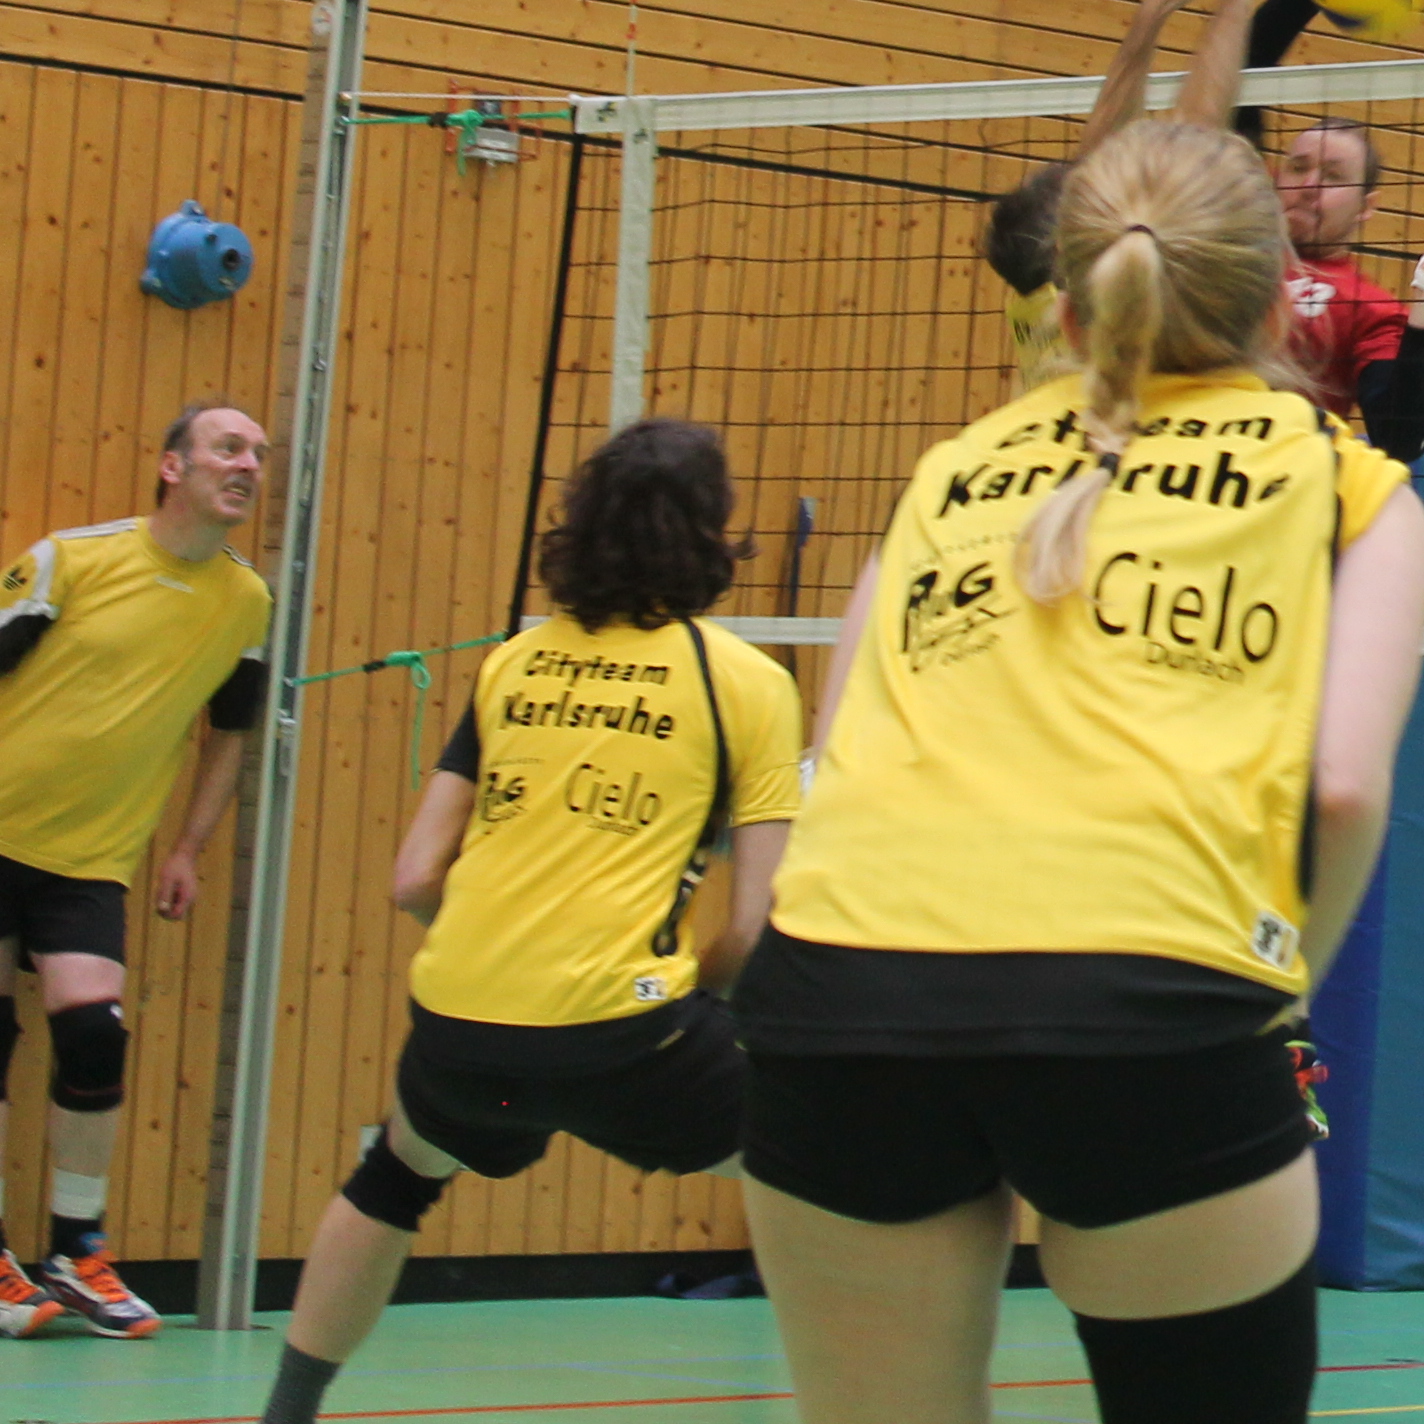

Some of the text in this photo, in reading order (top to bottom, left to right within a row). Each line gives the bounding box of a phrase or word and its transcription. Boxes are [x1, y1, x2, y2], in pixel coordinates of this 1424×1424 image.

[937, 451, 1290, 518] Karlruhe
[1093, 552, 1280, 664] Cielo
[500, 690, 675, 740] Karlsruhe
[564, 762, 663, 826] Cielo
